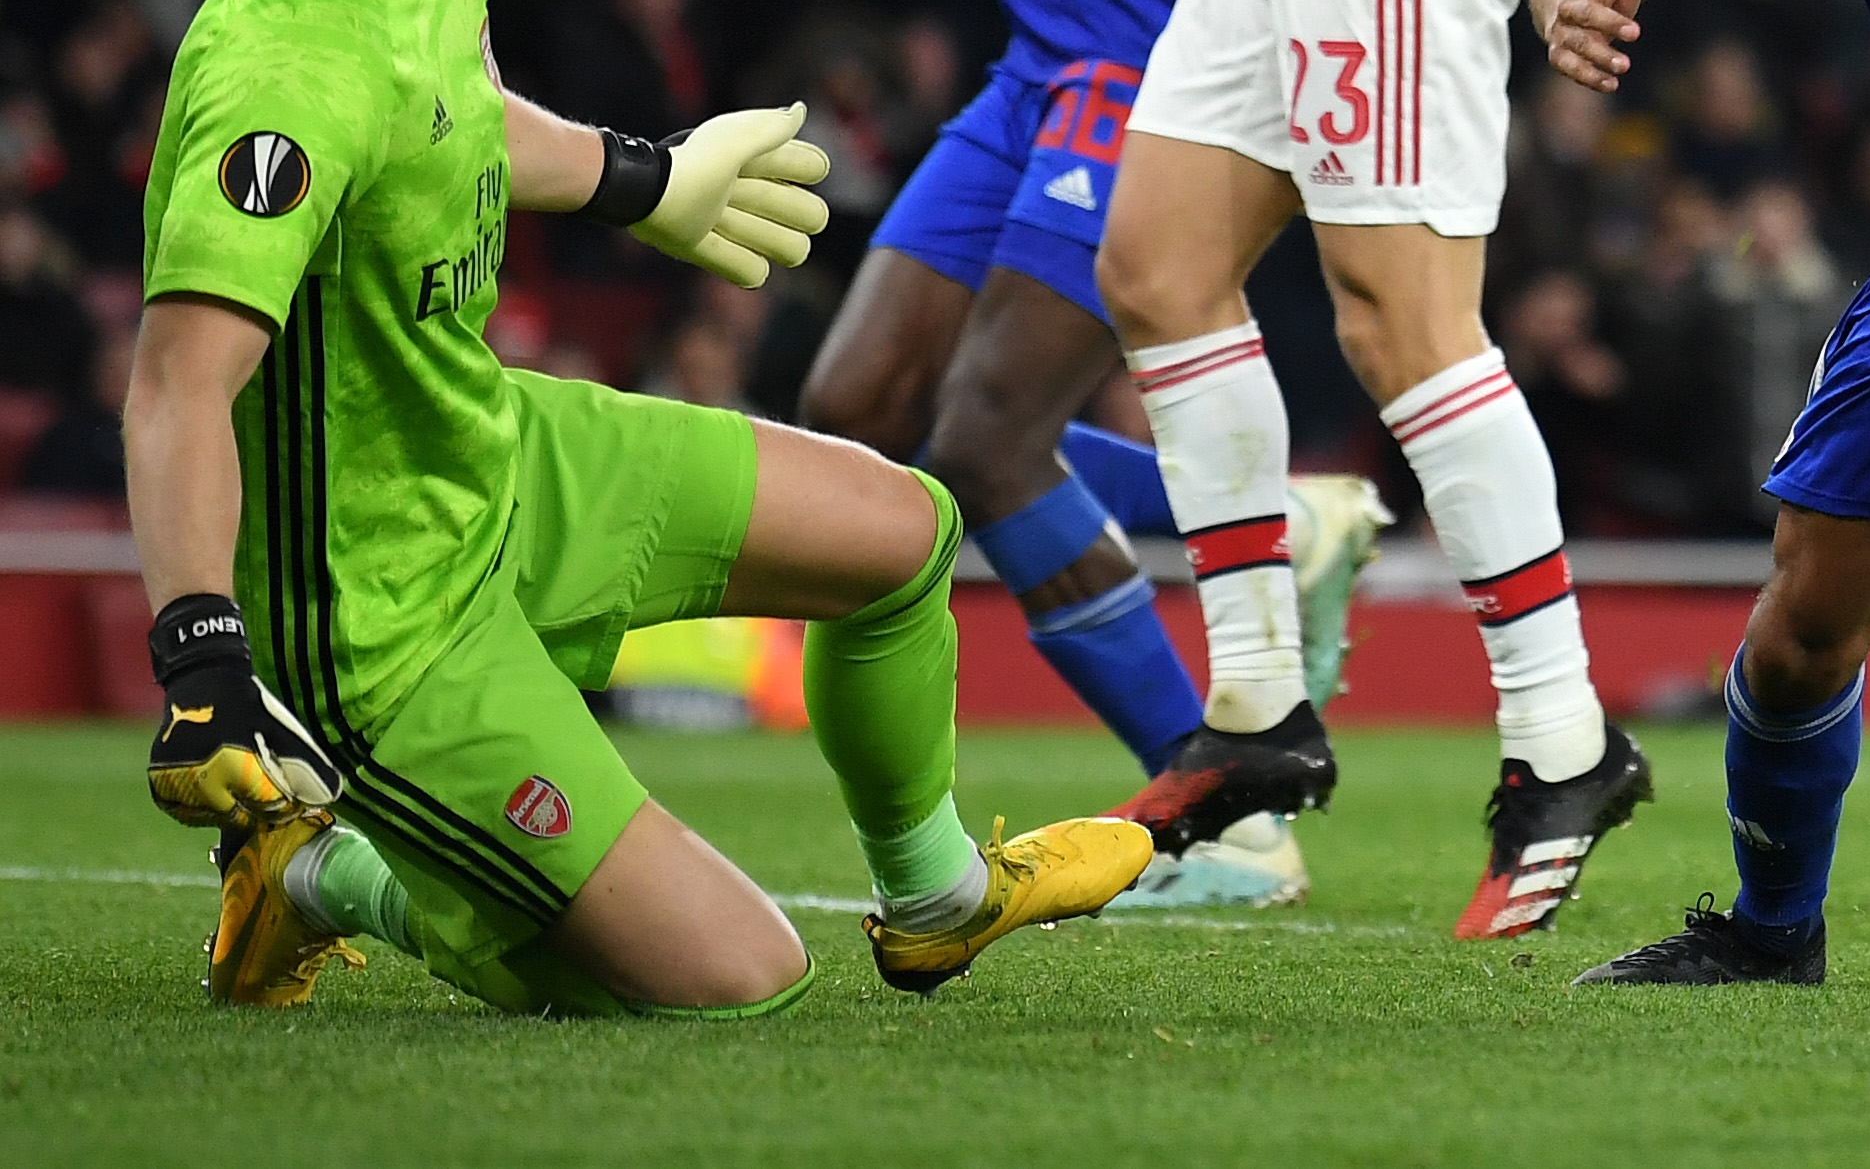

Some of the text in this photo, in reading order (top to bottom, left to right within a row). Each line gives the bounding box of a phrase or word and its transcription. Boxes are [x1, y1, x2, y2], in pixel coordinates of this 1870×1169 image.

[1290, 38, 1369, 146] 23
[475, 162, 502, 220] Fly
[177, 615, 246, 644] LENO 1
